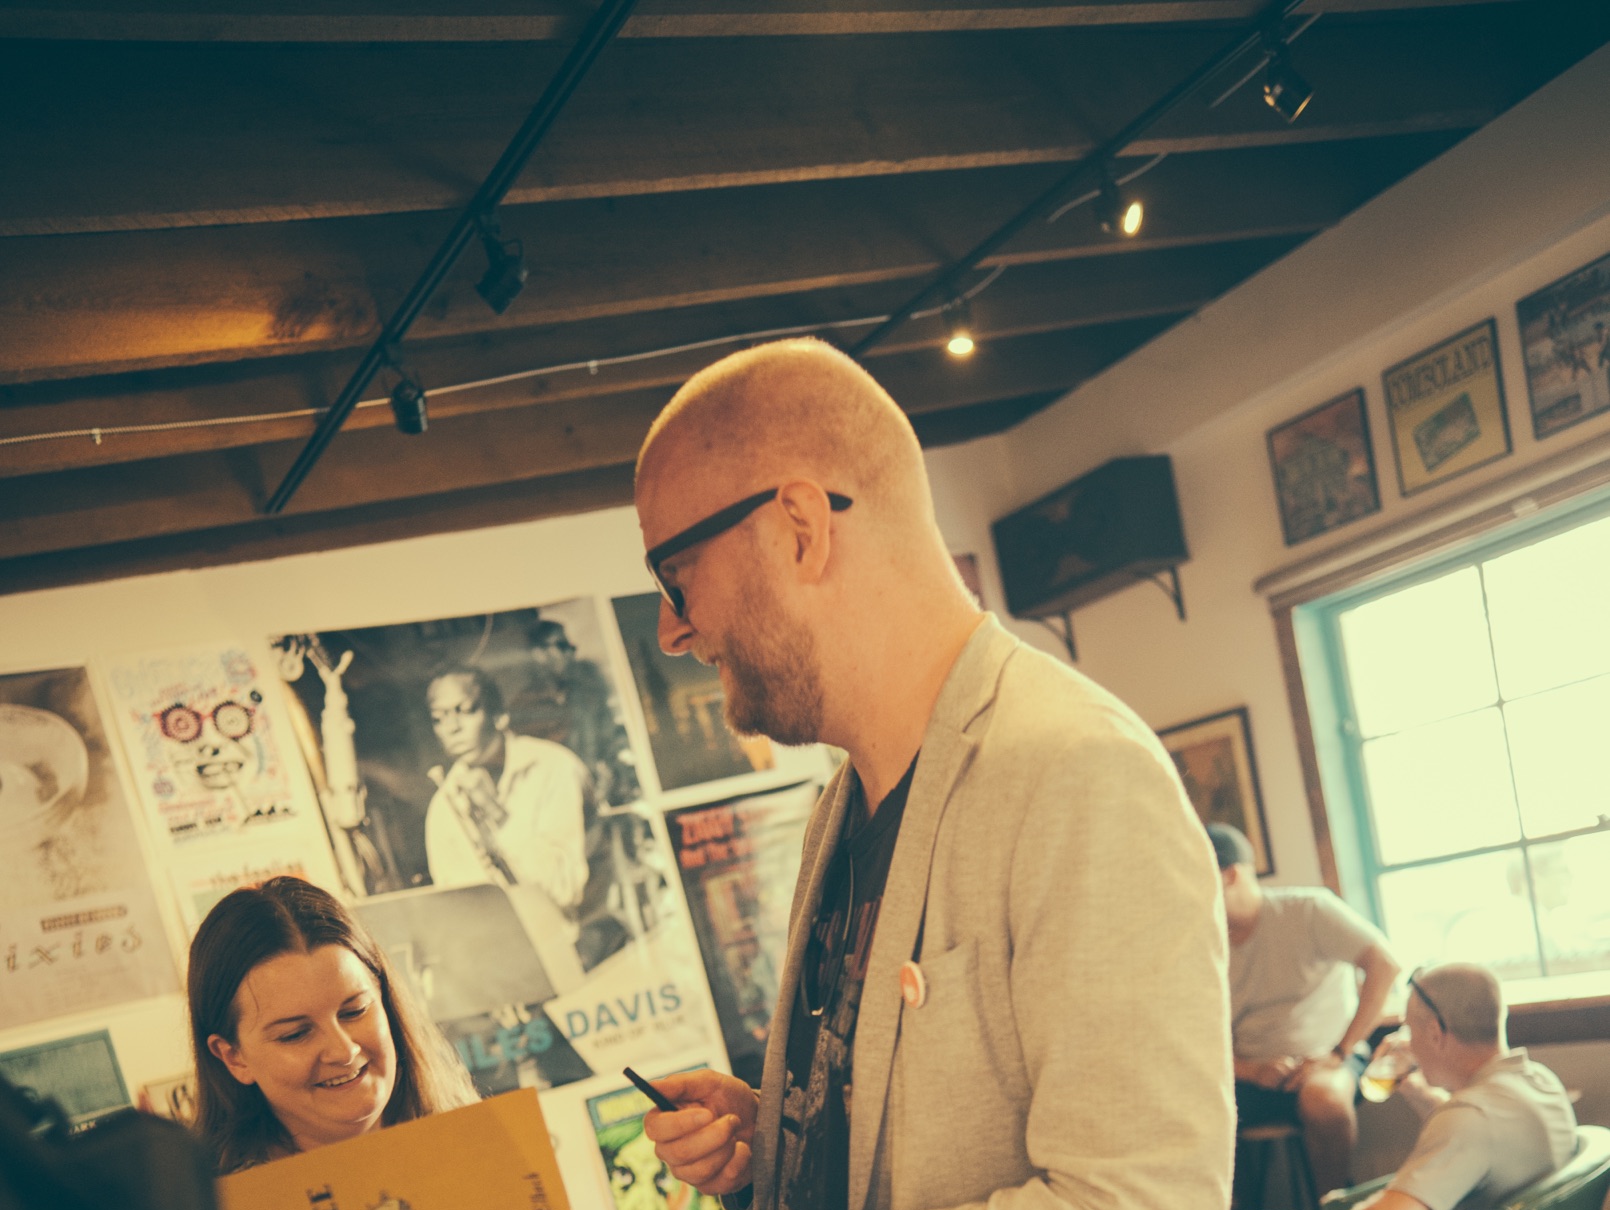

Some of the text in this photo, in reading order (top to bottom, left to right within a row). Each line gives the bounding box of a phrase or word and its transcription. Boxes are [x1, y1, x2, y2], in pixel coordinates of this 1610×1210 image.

[4, 926, 143, 974] ixies
[455, 983, 682, 1072] ILES DAVIS
